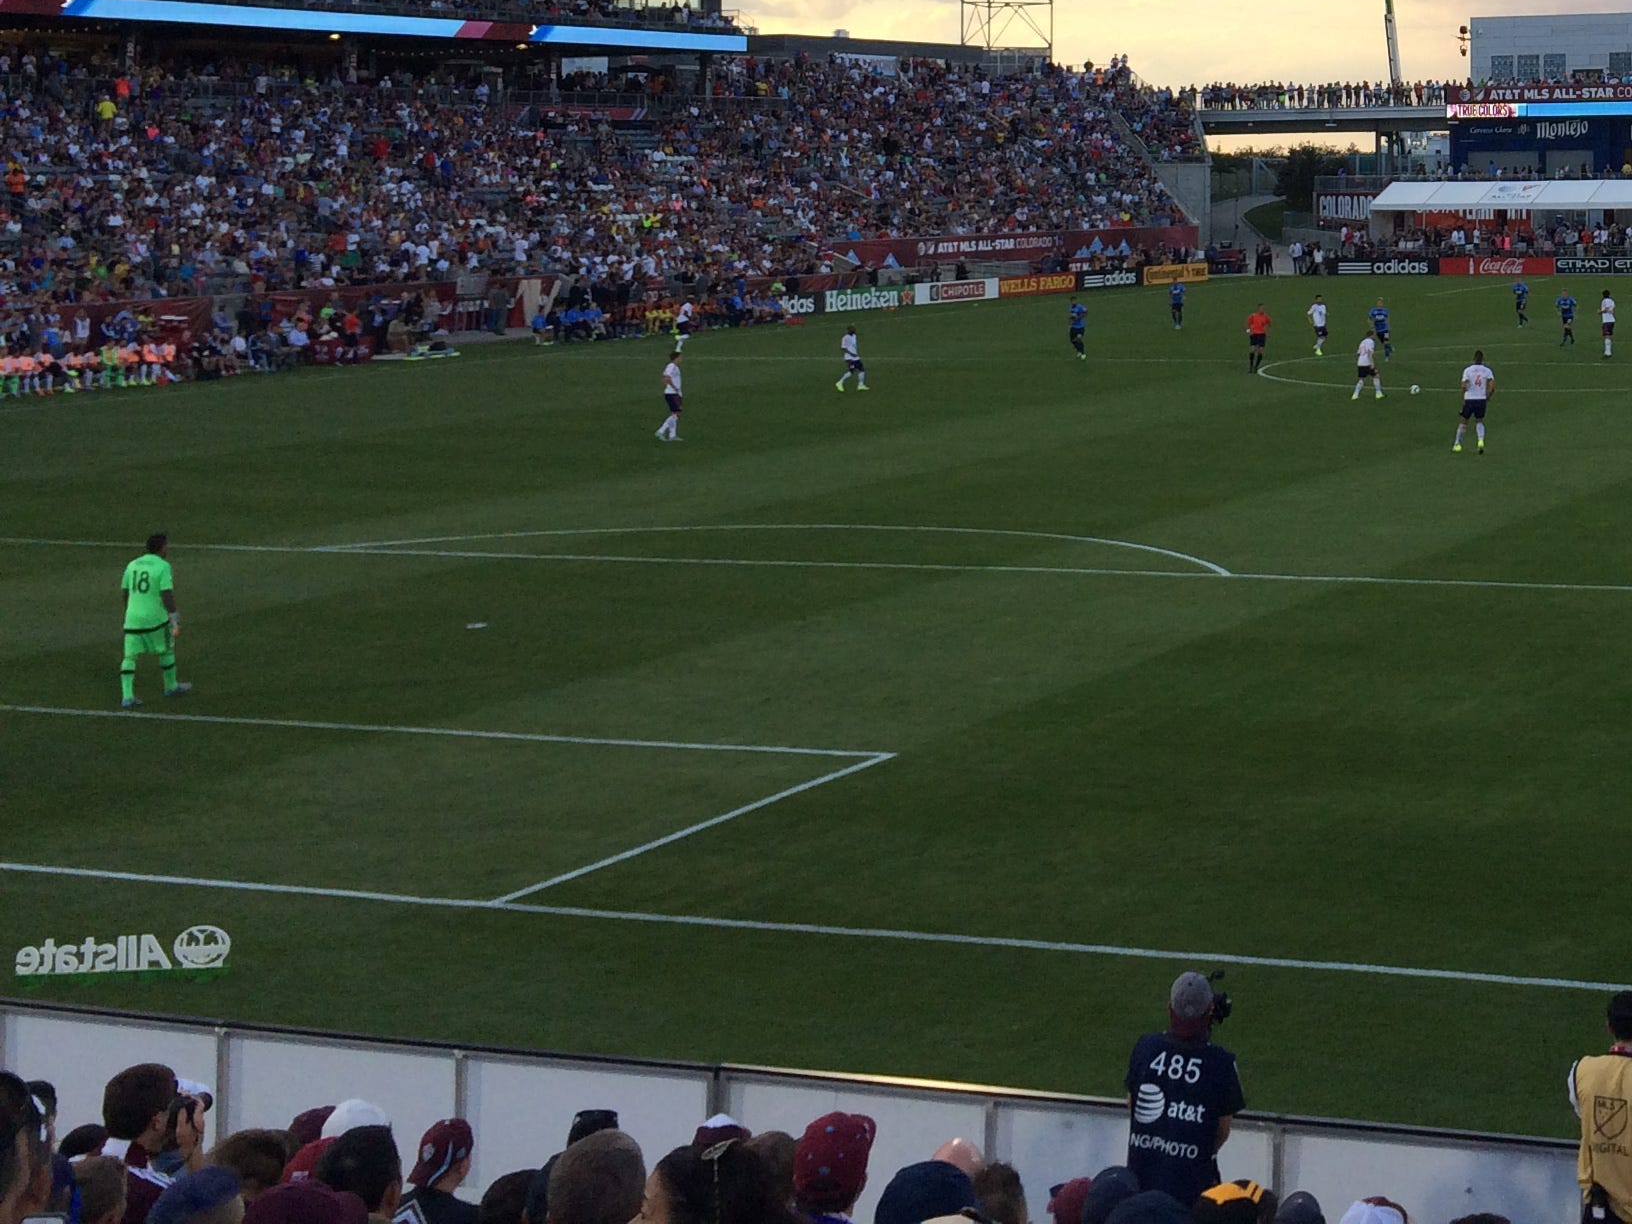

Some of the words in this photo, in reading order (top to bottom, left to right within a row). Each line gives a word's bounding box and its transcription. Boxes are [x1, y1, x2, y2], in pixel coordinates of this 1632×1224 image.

[1489, 89, 1521, 100] AT&T
[1524, 88, 1549, 100] MLS
[1553, 87, 1614, 99] ALL-STAR
[1016, 236, 1052, 249] COLORADO
[1373, 259, 1429, 274] adidas
[1556, 259, 1610, 269] ETIHAD
[941, 283, 985, 298] CHIPOTLE
[1001, 277, 1038, 293] WELLS
[1039, 274, 1076, 290] FARGO
[825, 287, 899, 313] Heineken
[132, 570, 150, 594] 18
[1149, 1051, 1202, 1083] 485
[1167, 1100, 1205, 1123] at&t
